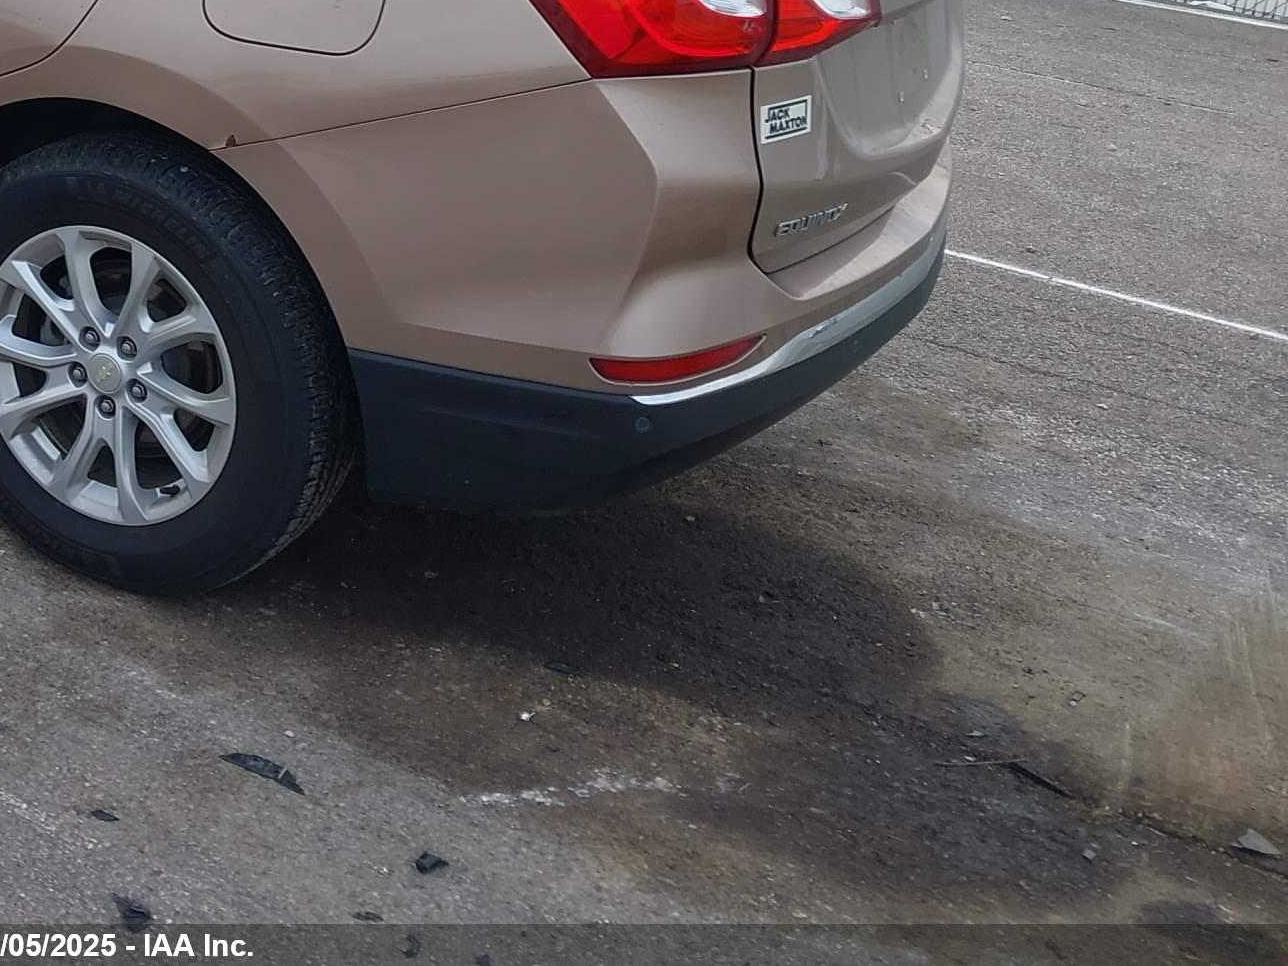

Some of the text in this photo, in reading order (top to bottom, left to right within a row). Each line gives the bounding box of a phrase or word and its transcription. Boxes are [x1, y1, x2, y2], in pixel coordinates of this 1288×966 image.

[765, 108, 790, 124] JACK
[769, 115, 808, 135] MAXTON
[113, 185, 212, 260] MICHELIN
